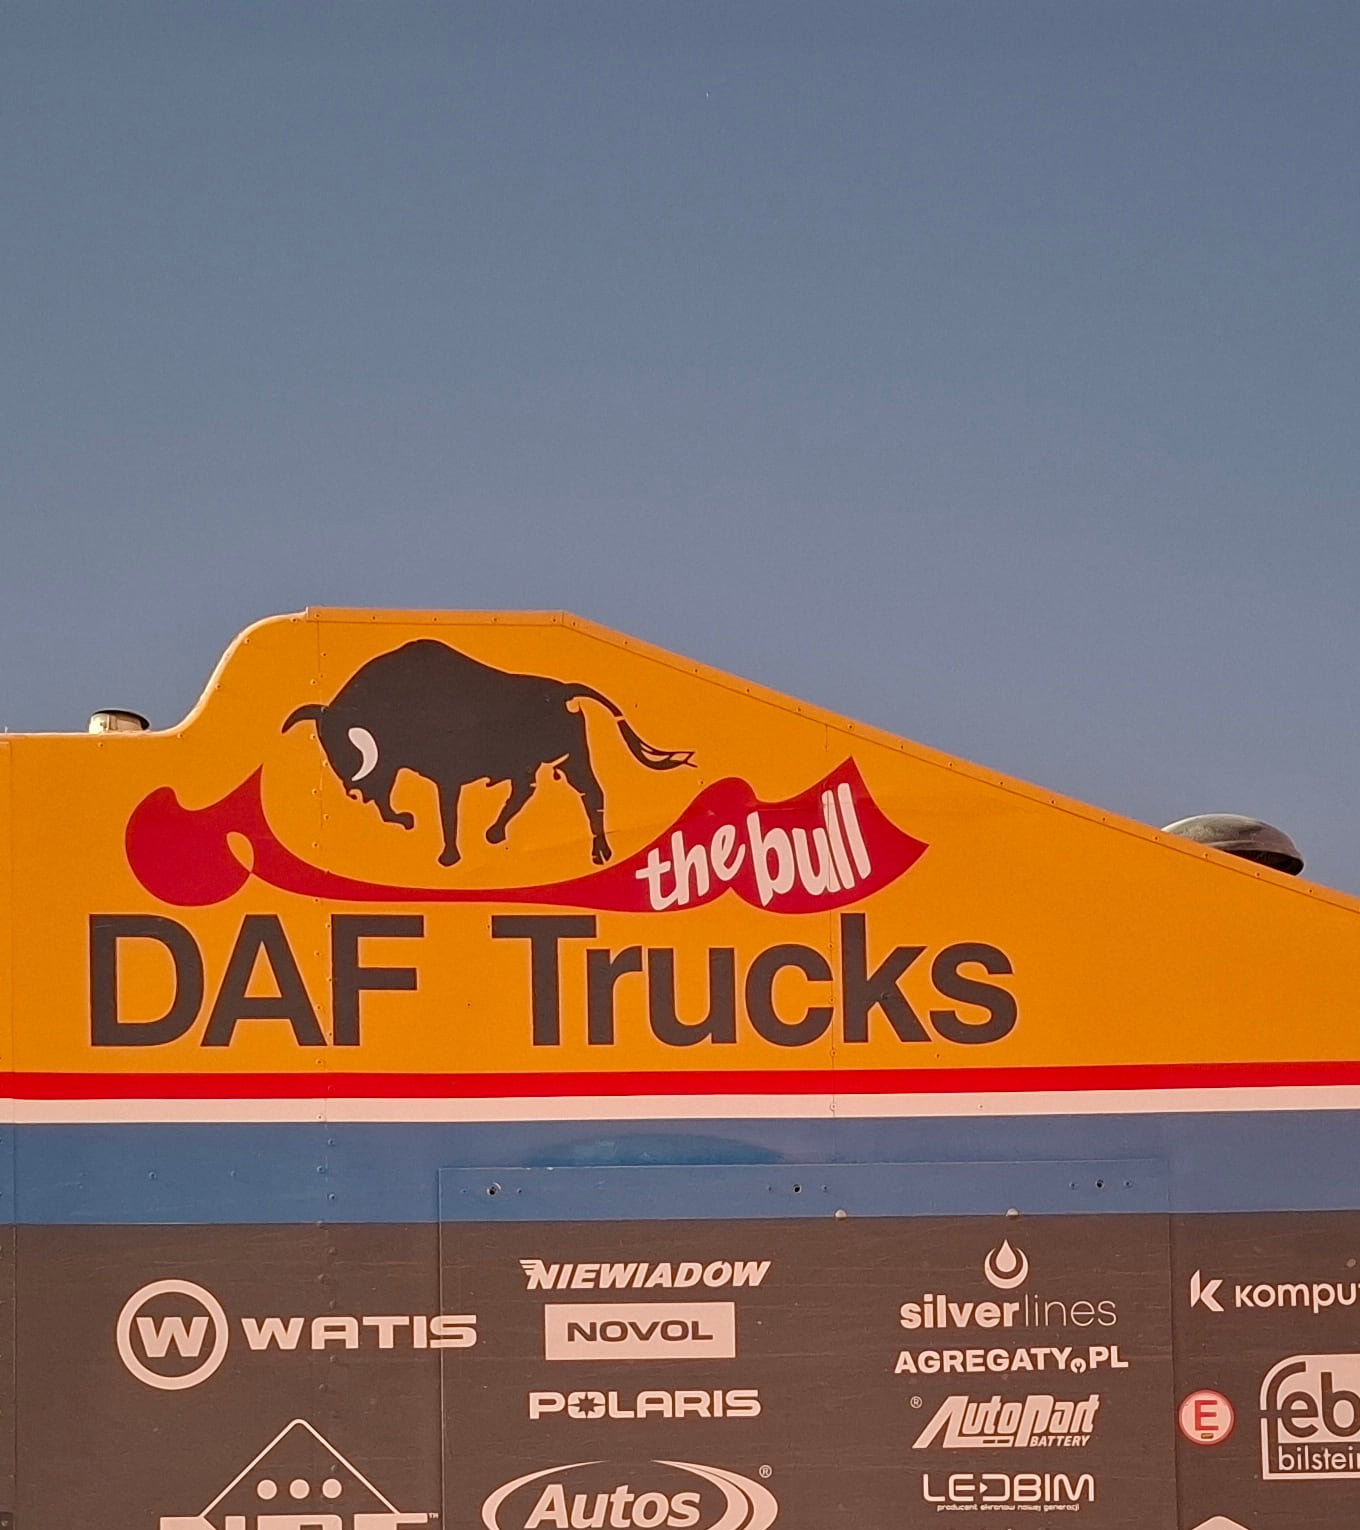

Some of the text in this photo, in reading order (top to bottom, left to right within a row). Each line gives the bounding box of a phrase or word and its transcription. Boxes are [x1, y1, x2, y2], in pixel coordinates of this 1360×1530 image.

[635, 781, 874, 912] the bull
[89, 913, 1019, 1048] DAF Trucks
[241, 1314, 478, 1350] WATIS
[567, 1320, 713, 1342] NOVOL
[529, 1390, 761, 1420] POLARIS
[1194, 1399, 1219, 1431] E
[1029, 1435, 1090, 1447] BATTERY
[923, 1473, 1095, 1502] LEDBIM
[523, 1484, 701, 1529] Autos
